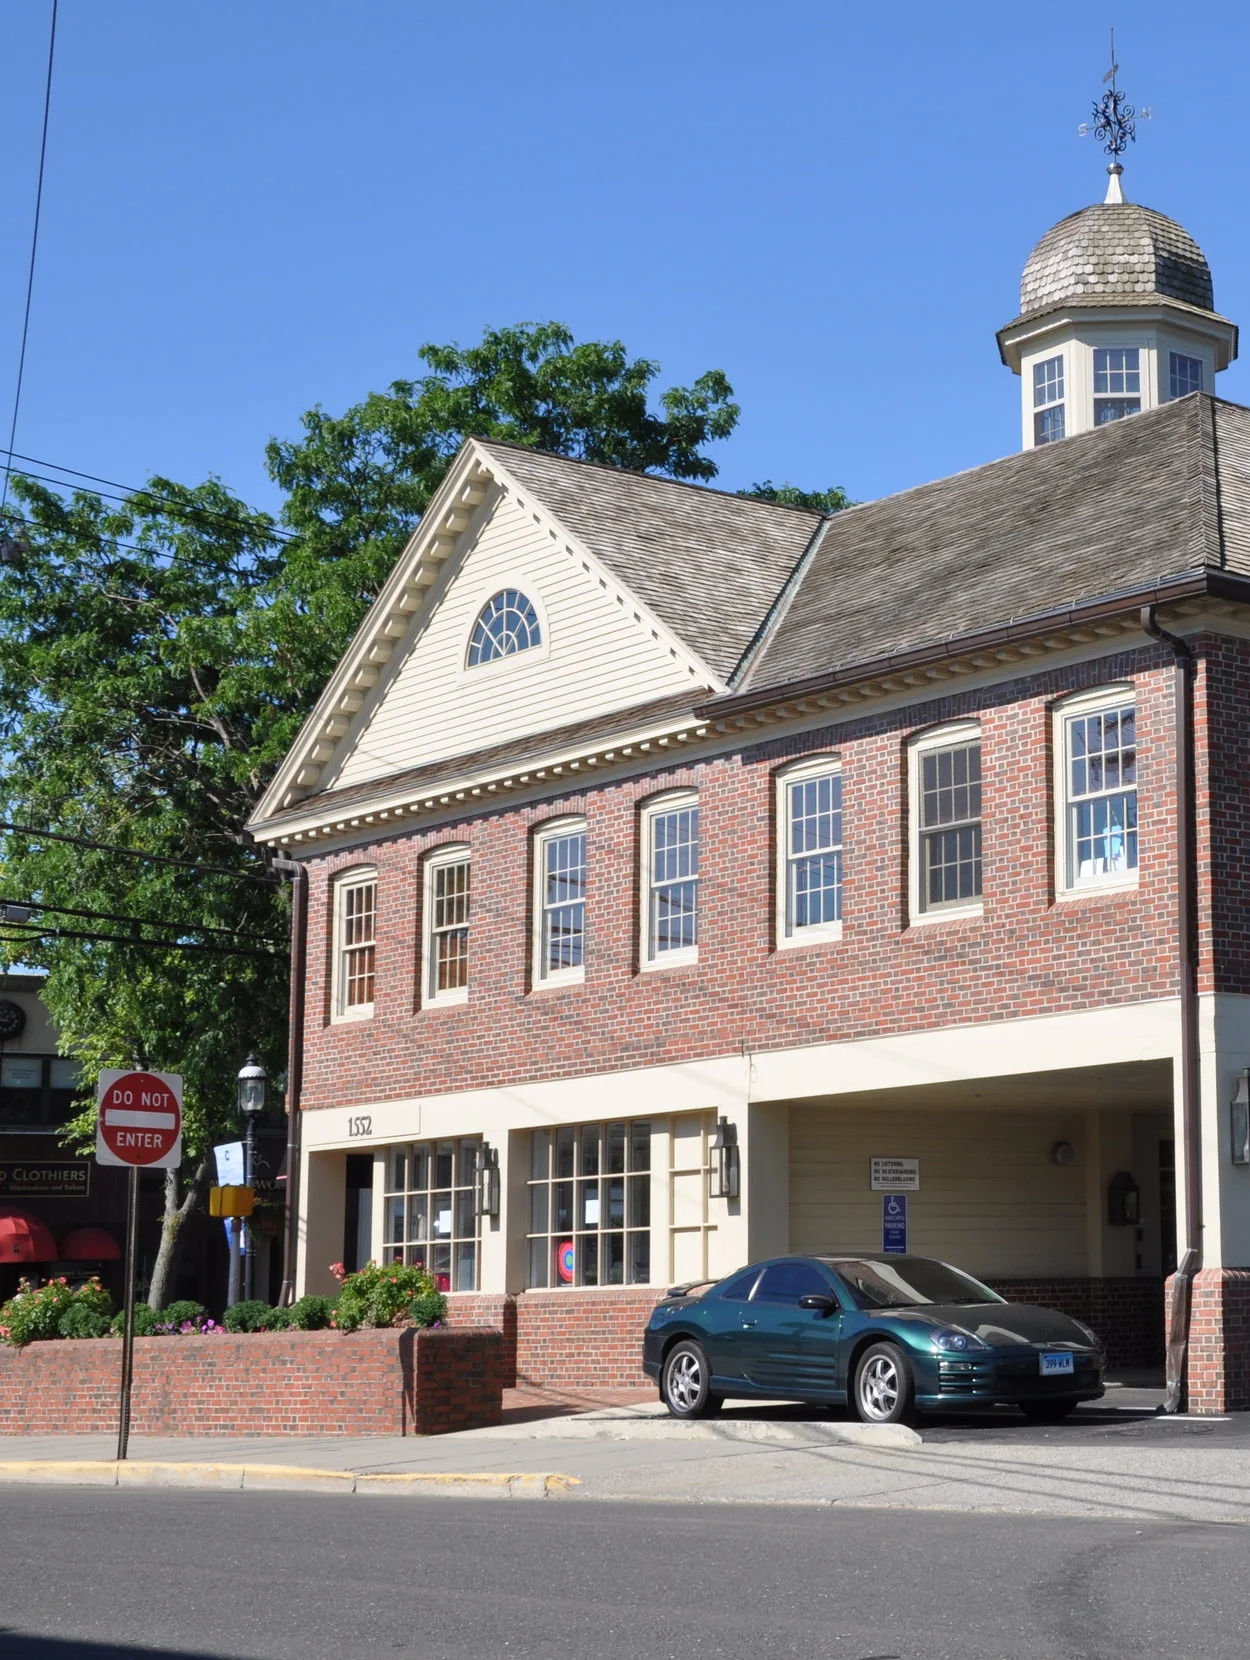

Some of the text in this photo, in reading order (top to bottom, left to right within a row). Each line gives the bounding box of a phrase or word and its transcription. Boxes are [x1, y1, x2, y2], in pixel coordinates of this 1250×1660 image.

[113, 1090, 169, 1107] DO NOT
[348, 1115, 372, 1137] 1552
[116, 1132, 162, 1148] ENTER
[12, 1168, 86, 1181] CLOTHIERS
